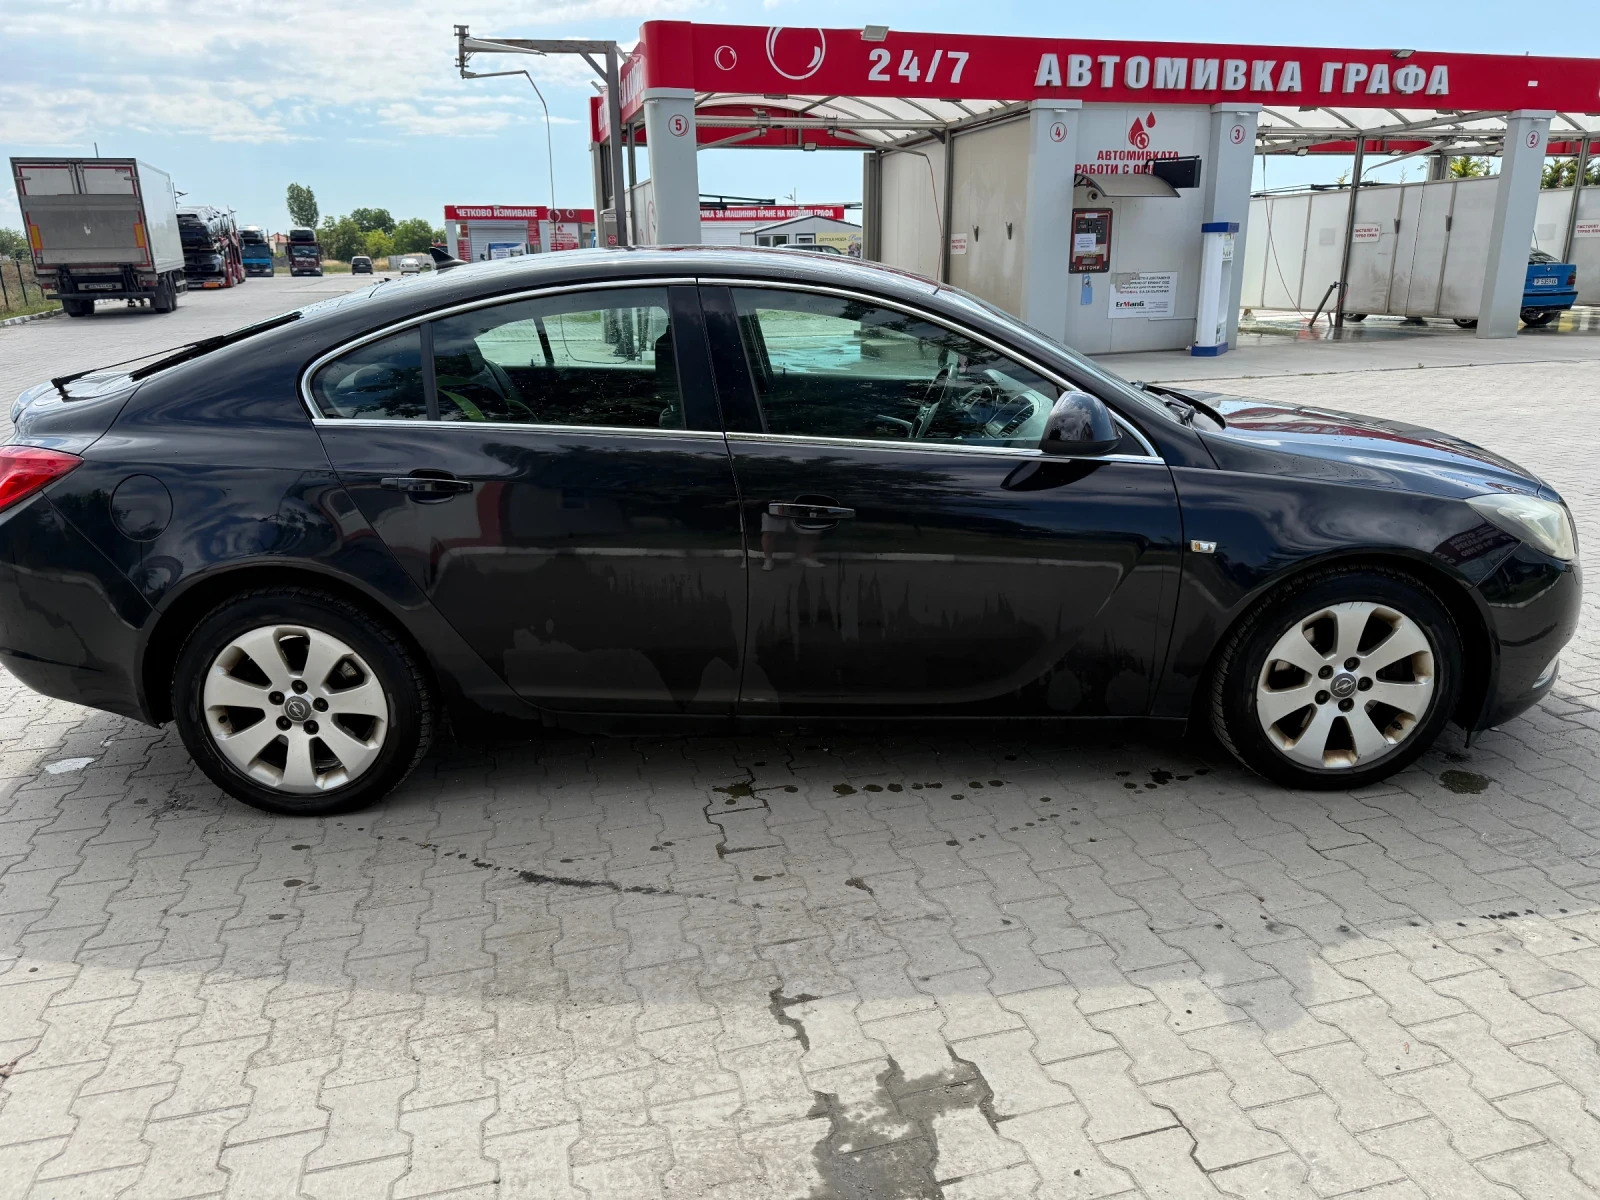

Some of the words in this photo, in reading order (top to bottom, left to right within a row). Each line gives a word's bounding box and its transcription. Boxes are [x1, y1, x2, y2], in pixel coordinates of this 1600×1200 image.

[868, 48, 969, 84] 24/7
[1033, 53, 1302, 92] АВТОМИВКА
[1319, 61, 1449, 95] ГРАФА
[675, 118, 682, 131] 5
[1055, 126, 1061, 138] 4
[1234, 129, 1241, 141] 3
[1529, 134, 1536, 145] 2
[1097, 150, 1179, 161] АВТОМИВКАТА
[1074, 164, 1119, 174] РАБОТИ
[456, 208, 492, 217] ЧЕТКОВО
[493, 209, 538, 218] ИЗМИВАНЕ
[716, 210, 724, 218] ЗА
[725, 209, 757, 218] МАШИННО
[757, 209, 777, 217] ПРАНЕ
[777, 209, 785, 217] НА
[814, 209, 834, 217] ГРАФА
